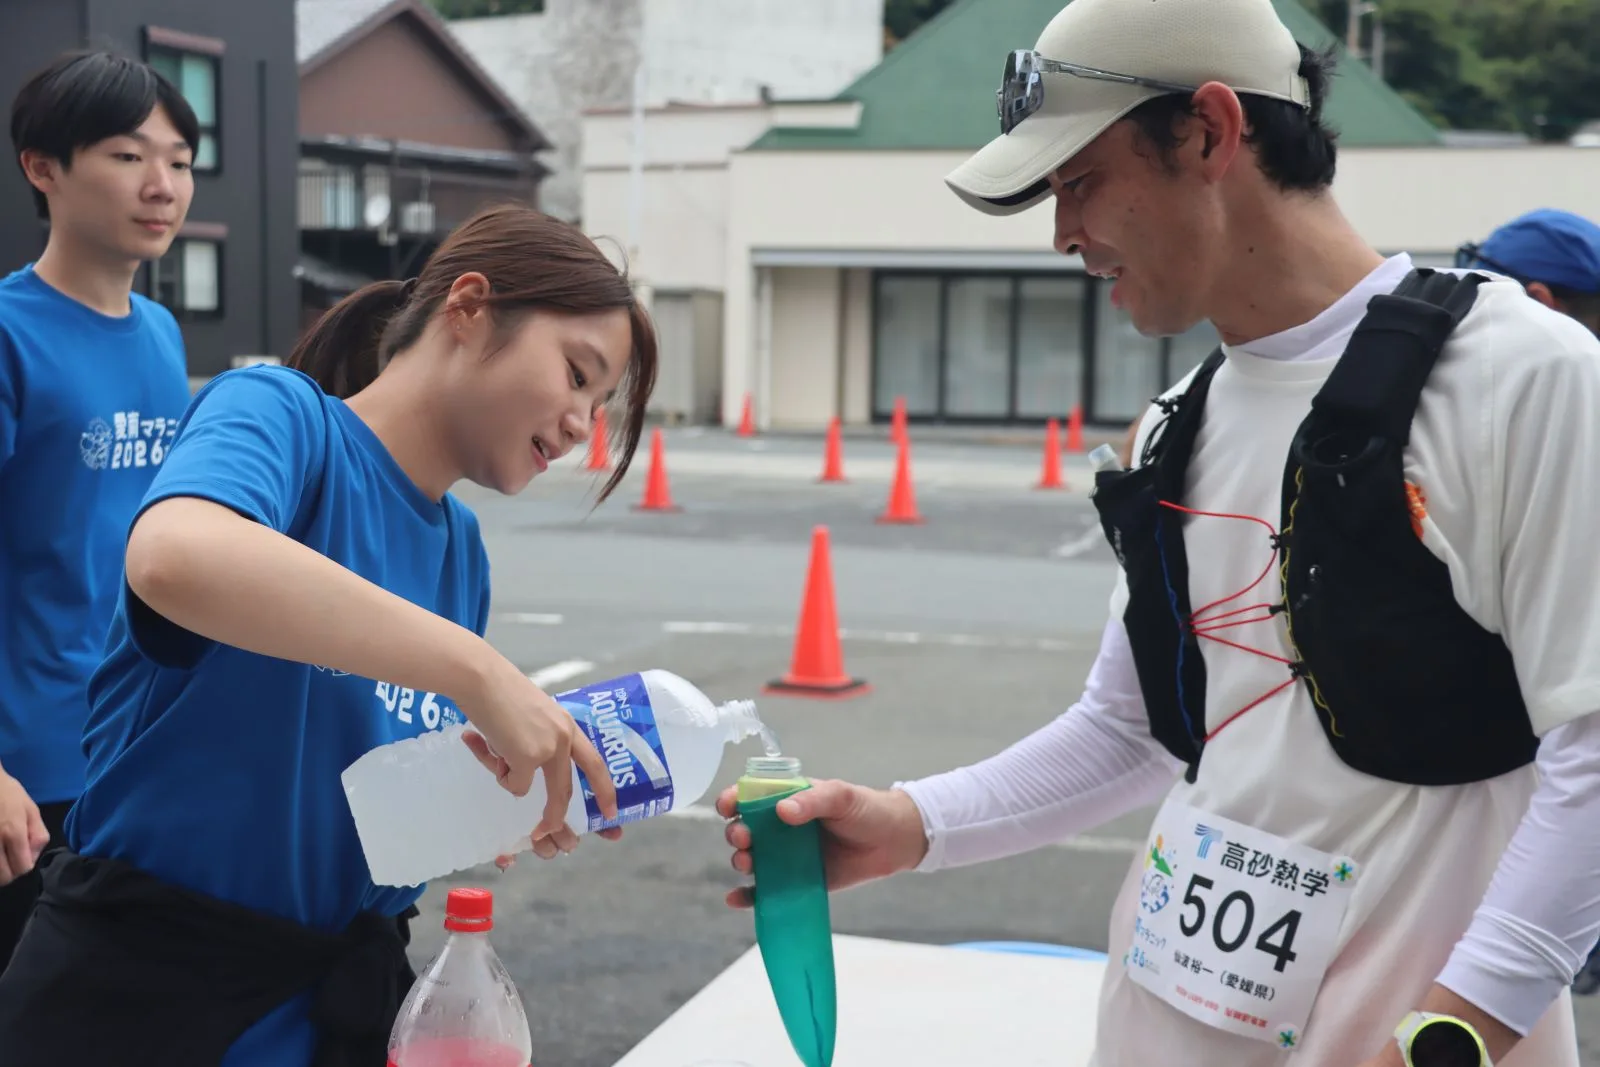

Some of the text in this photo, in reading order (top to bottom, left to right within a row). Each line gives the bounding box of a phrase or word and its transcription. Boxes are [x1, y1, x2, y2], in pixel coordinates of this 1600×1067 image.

[111, 439, 164, 469] 2026
[588, 690, 637, 788] AQUARIUS
[1220, 840, 1330, 897] 高砂熱学
[1179, 873, 1302, 973] 504
